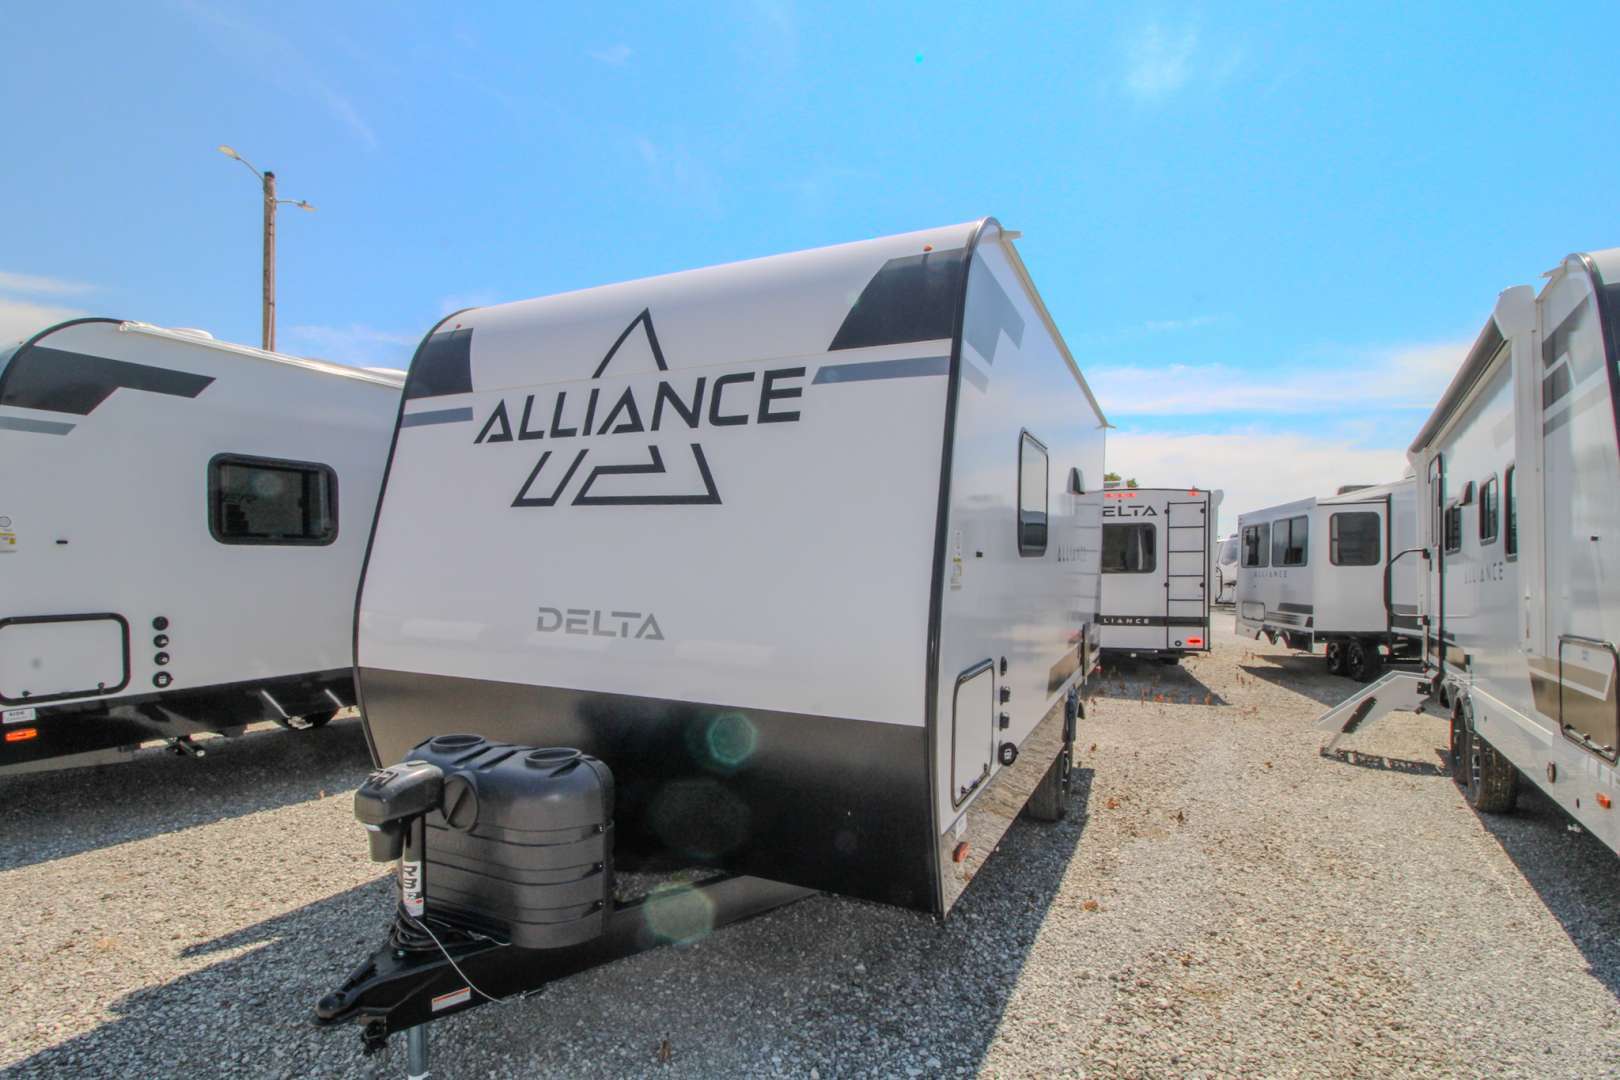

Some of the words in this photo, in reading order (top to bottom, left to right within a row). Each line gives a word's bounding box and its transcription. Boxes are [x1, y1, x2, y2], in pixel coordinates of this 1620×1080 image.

[473, 366, 806, 444] ALLIANCE
[1102, 505, 1158, 517] ELTA
[536, 606, 665, 641] DELTA
[1103, 617, 1150, 625] LIANCE
